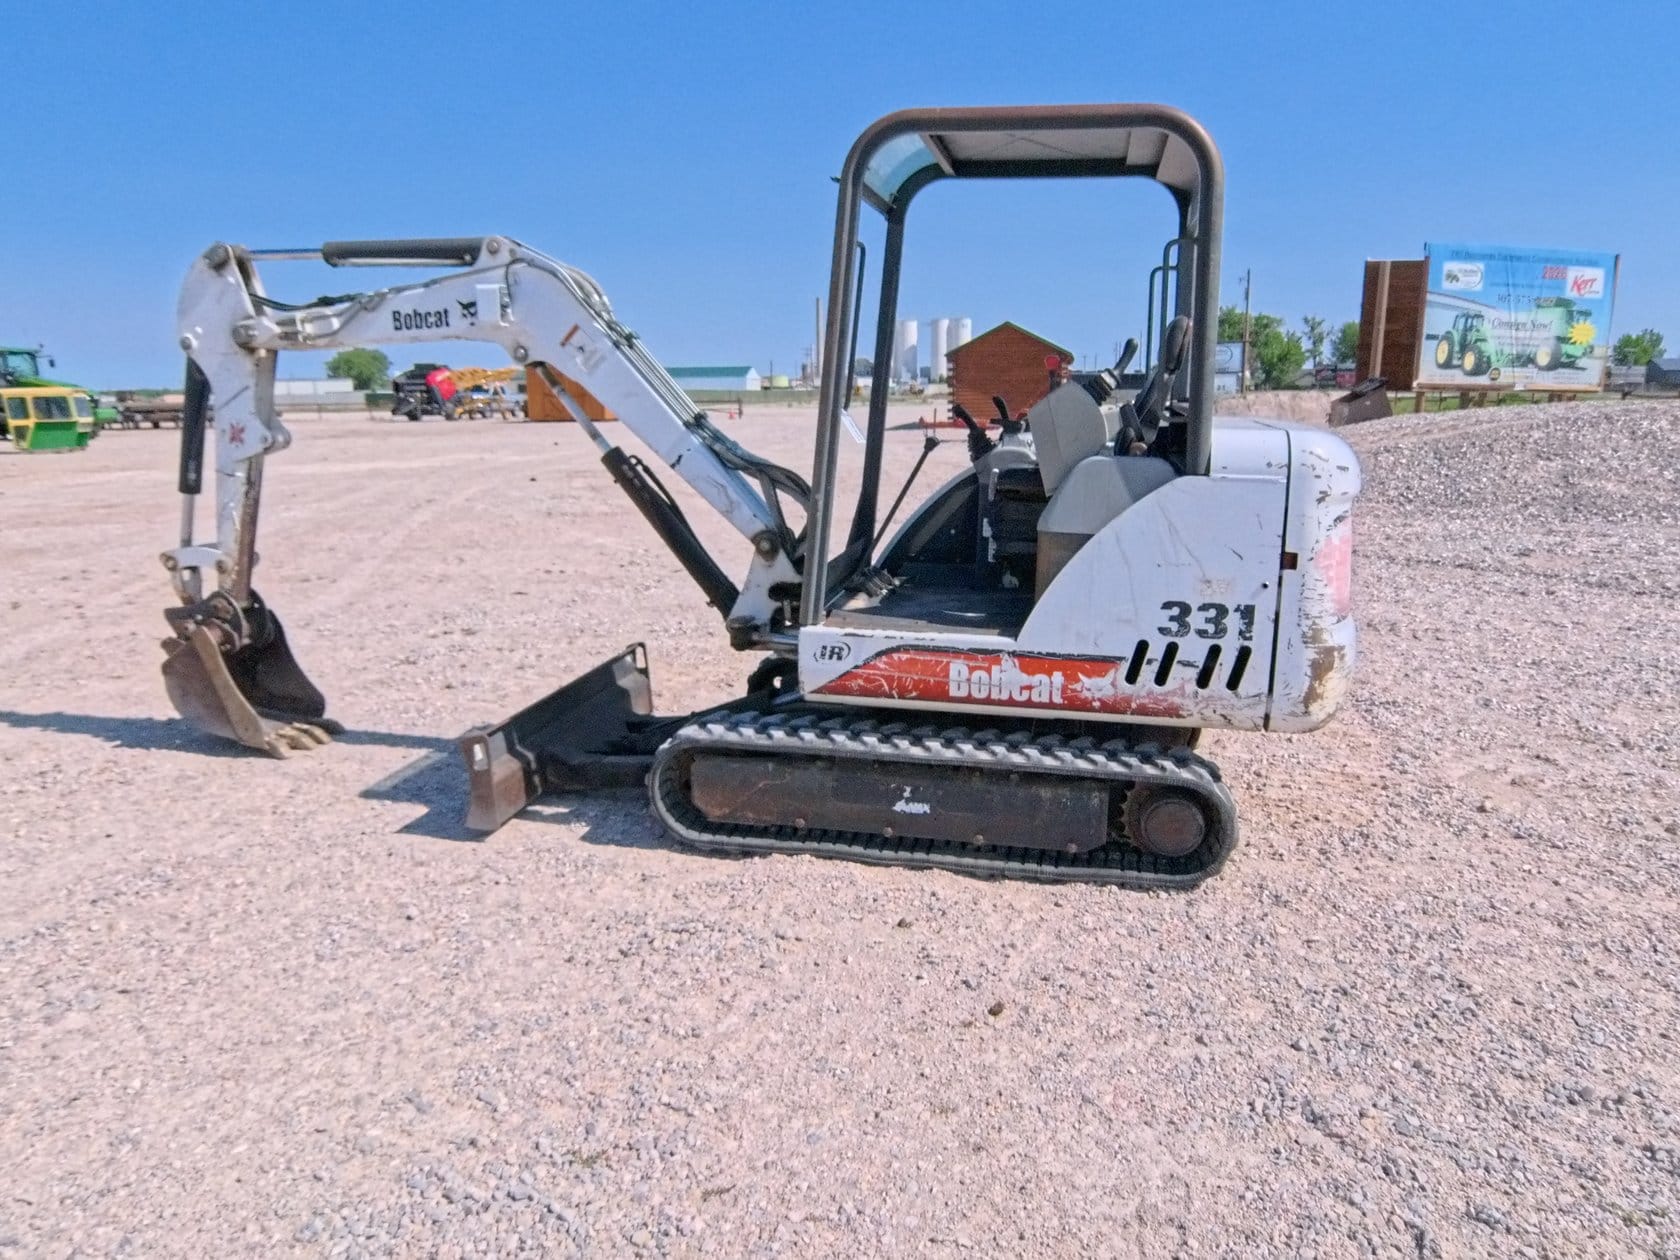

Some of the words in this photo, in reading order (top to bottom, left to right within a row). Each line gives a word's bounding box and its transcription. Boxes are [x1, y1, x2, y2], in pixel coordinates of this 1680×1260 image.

[392, 308, 450, 331] Bobcat
[1157, 600, 1256, 641] 331
[948, 659, 1064, 705] Bobcat
